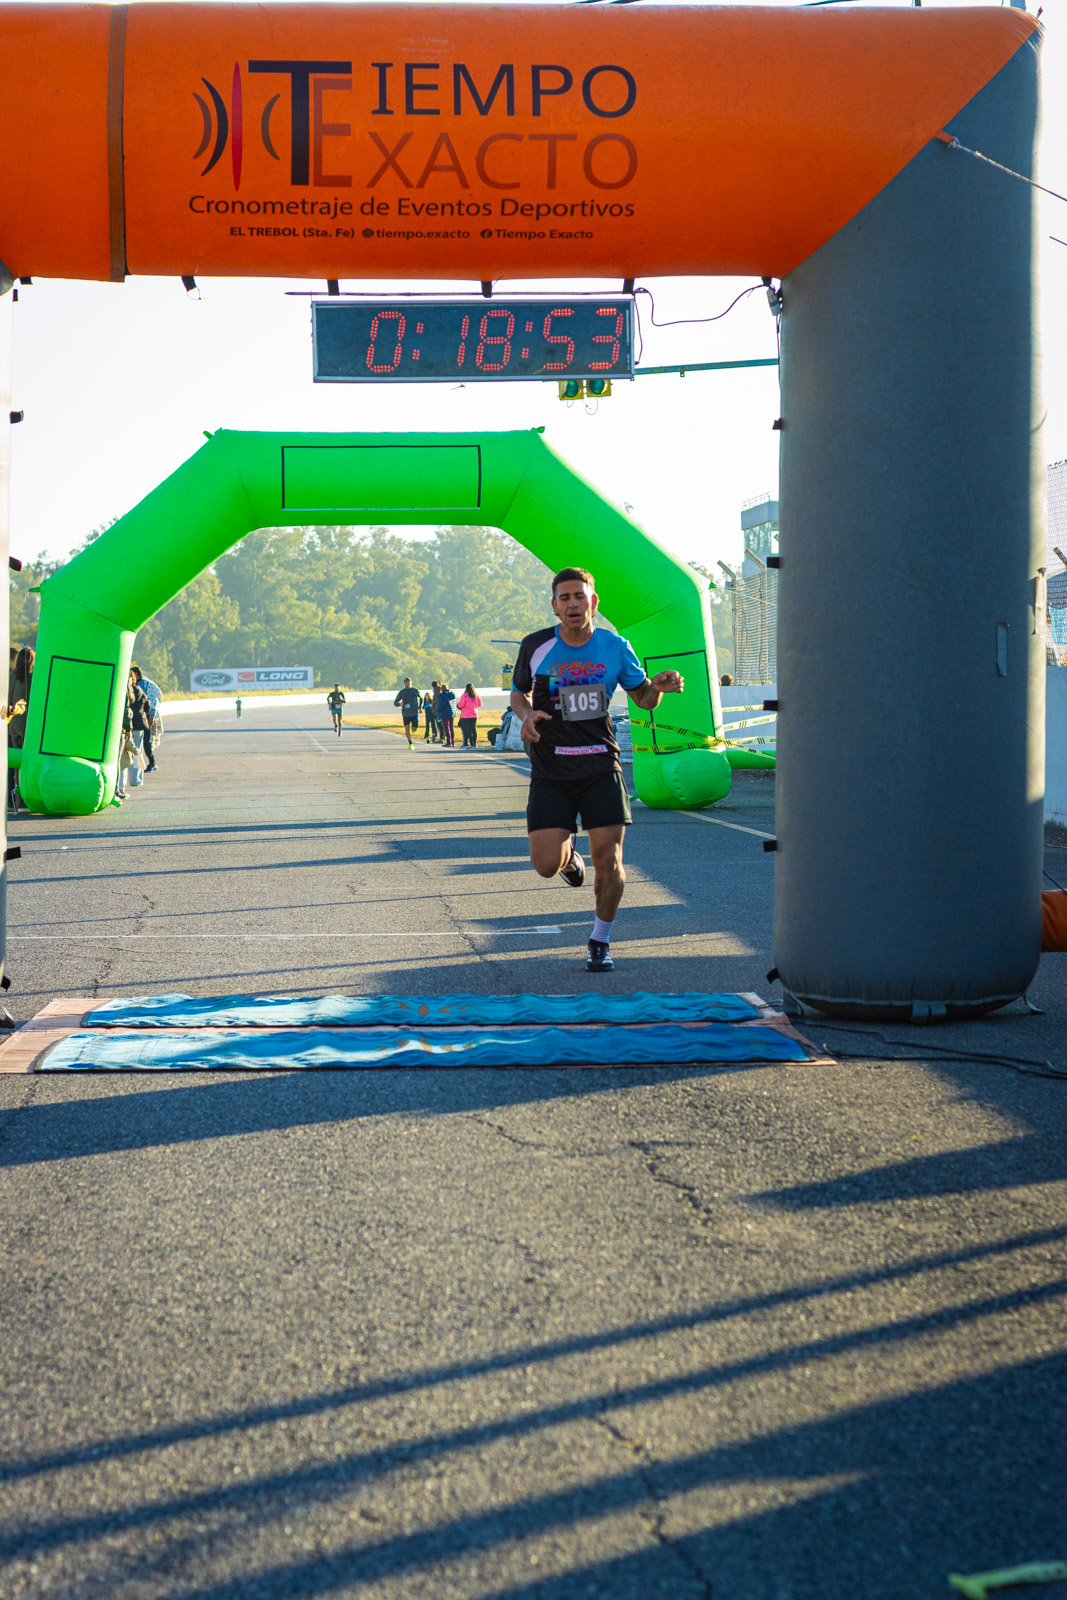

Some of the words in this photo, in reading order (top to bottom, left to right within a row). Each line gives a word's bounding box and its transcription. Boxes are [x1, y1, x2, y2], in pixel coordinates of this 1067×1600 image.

[188, 195, 353, 220] Cronometraje
[360, 197, 390, 216] de
[398, 198, 492, 216] Eventos
[501, 198, 635, 221] Deportivos
[230, 227, 246, 236] EL
[247, 227, 300, 237] TREBOL
[302, 227, 332, 238] (Sta.
[335, 227, 355, 239] Fe)
[376, 229, 470, 240] tiempo.exacto
[495, 229, 546, 240] Tiempo
[550, 230, 593, 239] Exacto
[201, 673, 225, 686] Ford
[259, 672, 304, 681] LONG
[569, 692, 599, 712] 105
